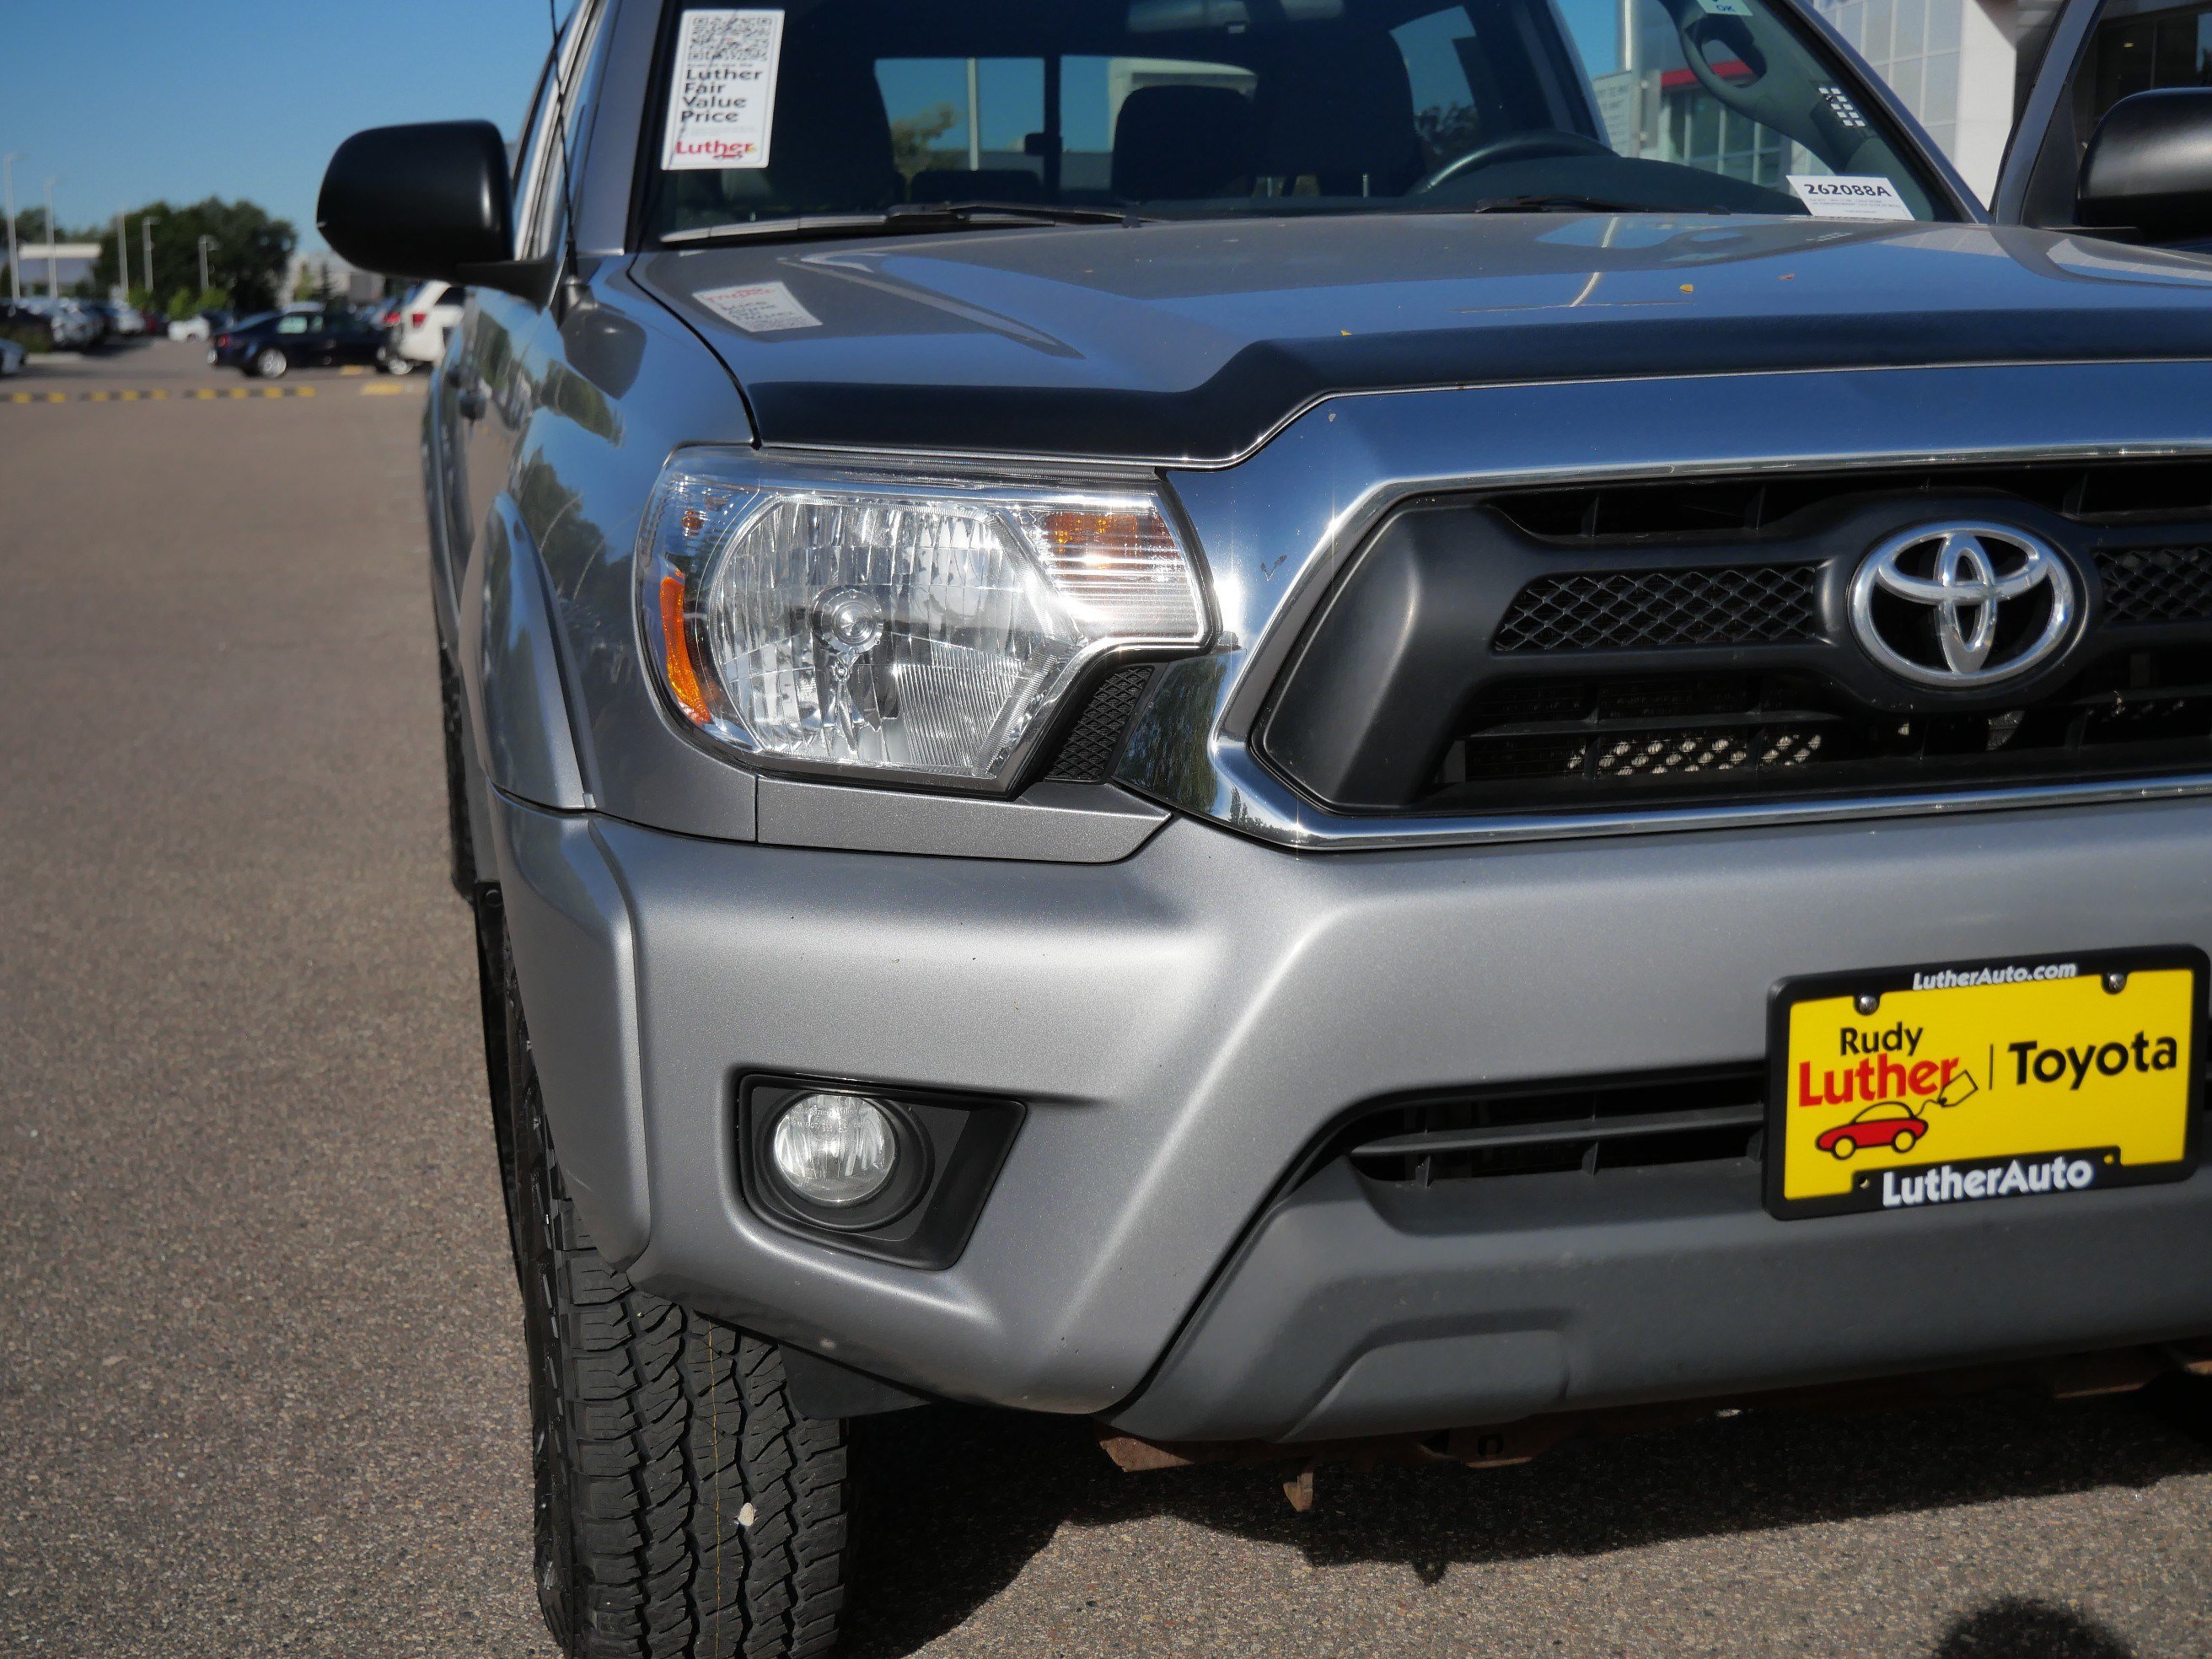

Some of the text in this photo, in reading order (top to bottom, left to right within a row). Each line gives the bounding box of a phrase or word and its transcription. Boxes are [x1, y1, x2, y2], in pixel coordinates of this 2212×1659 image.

[686, 68, 763, 81] Luther
[684, 82, 726, 94] Fair
[682, 95, 747, 109] Value
[680, 110, 738, 123] Price
[675, 140, 754, 155] Luther
[1804, 184, 1892, 197] 262088A
[1912, 963, 2079, 991] LutherAuto.com
[1839, 1022, 1924, 1056] Rudy
[1798, 1030, 2179, 1108] Luther Toyota
[1882, 1155, 2094, 1209] LutherAuto
